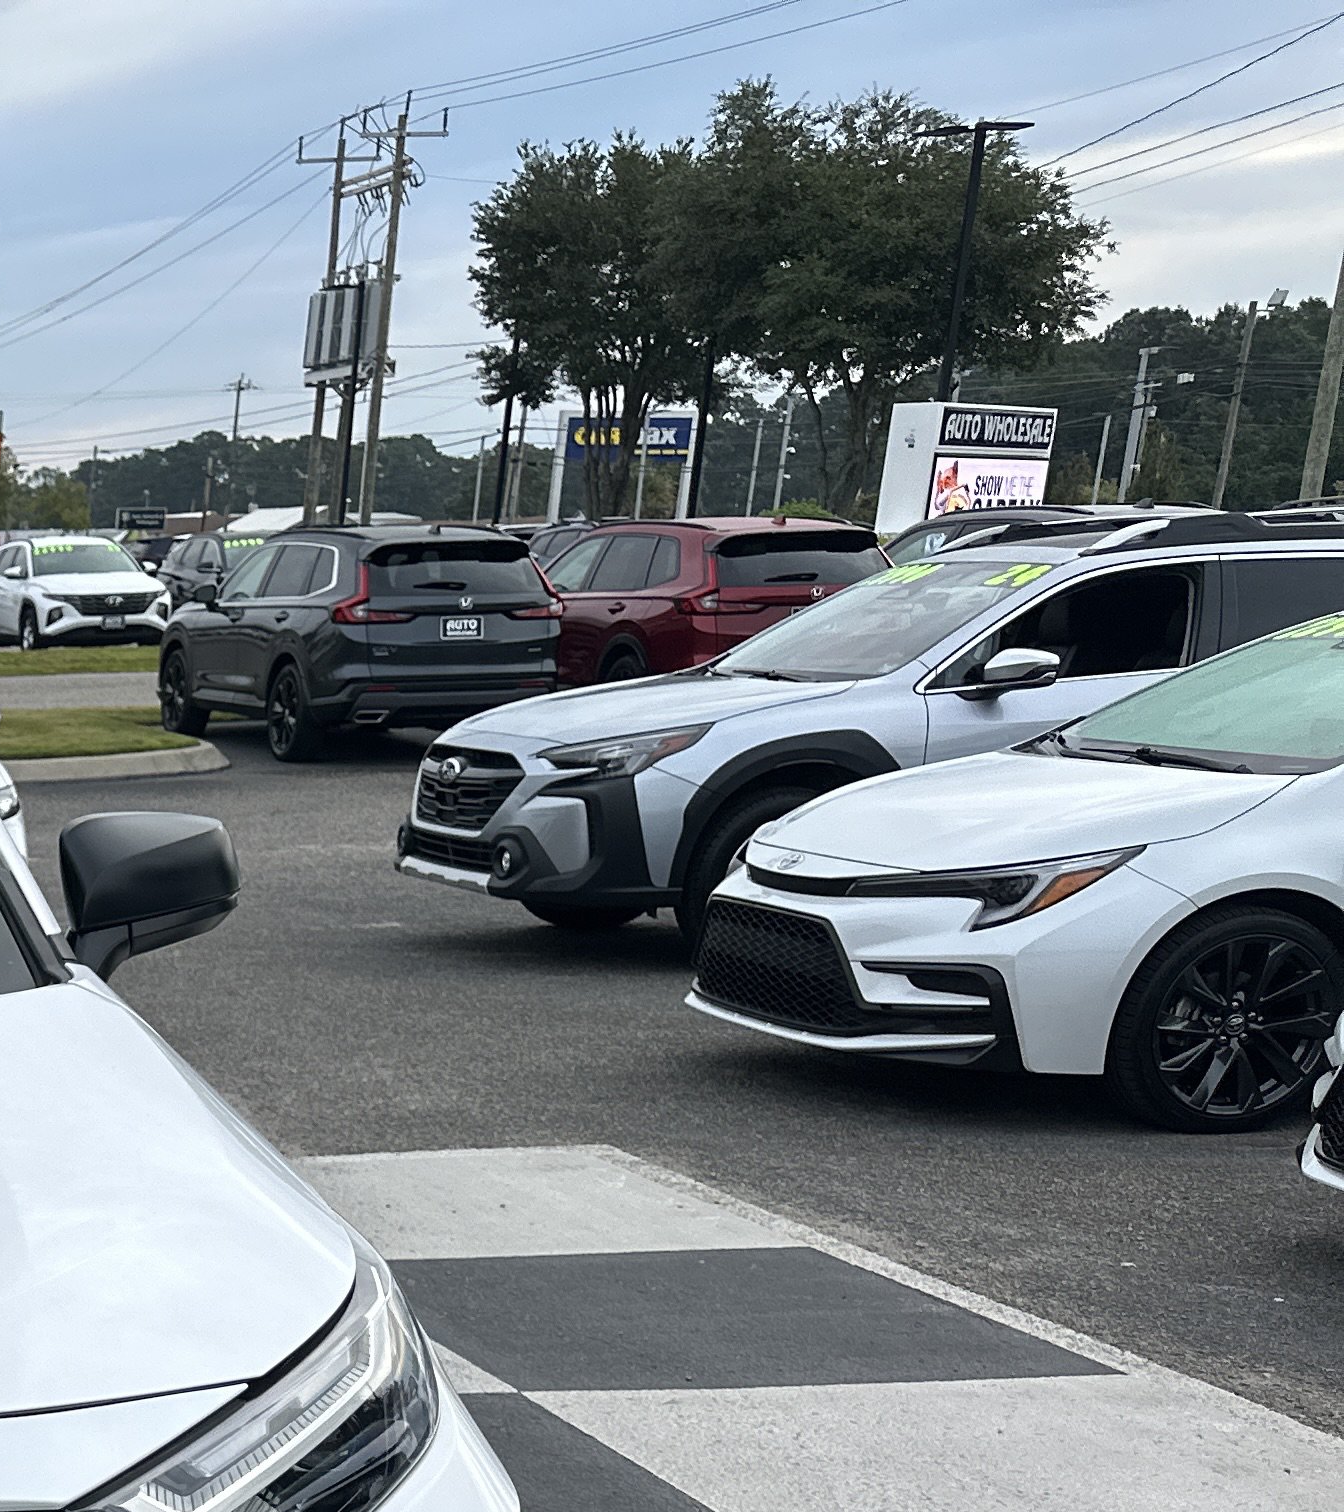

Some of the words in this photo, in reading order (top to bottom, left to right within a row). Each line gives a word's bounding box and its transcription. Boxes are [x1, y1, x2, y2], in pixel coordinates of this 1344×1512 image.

[945, 413, 981, 441] AUTO
[984, 415, 1052, 444] WHOLESALE
[974, 475, 1004, 496] SHOW
[446, 619, 478, 631] AUTO
